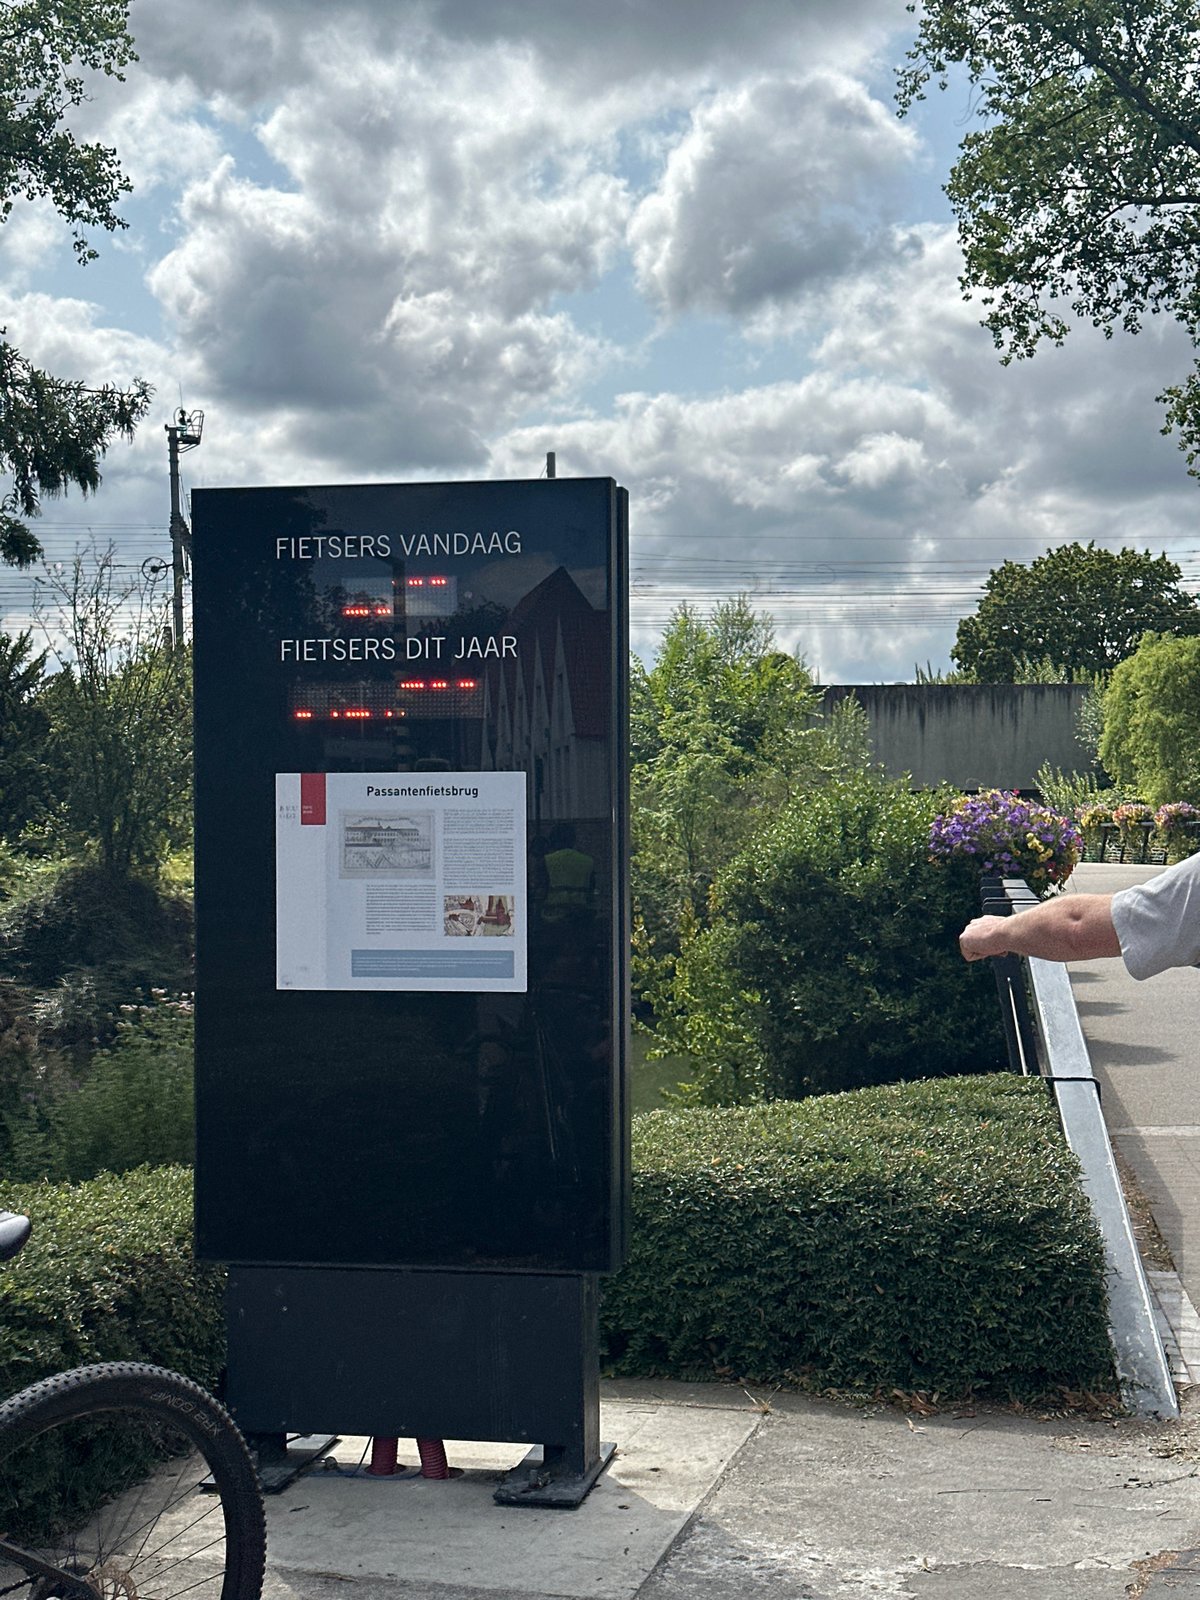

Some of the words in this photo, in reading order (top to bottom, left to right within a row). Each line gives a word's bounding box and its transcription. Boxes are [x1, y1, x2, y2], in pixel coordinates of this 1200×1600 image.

[276, 534, 391, 559] FIETSERS
[400, 531, 522, 556] VANDAAG
[281, 637, 396, 661] FIETSERS
[406, 636, 446, 659] DIT
[454, 635, 518, 659] JAAR
[366, 785, 479, 798] Passantenfietsbrug
